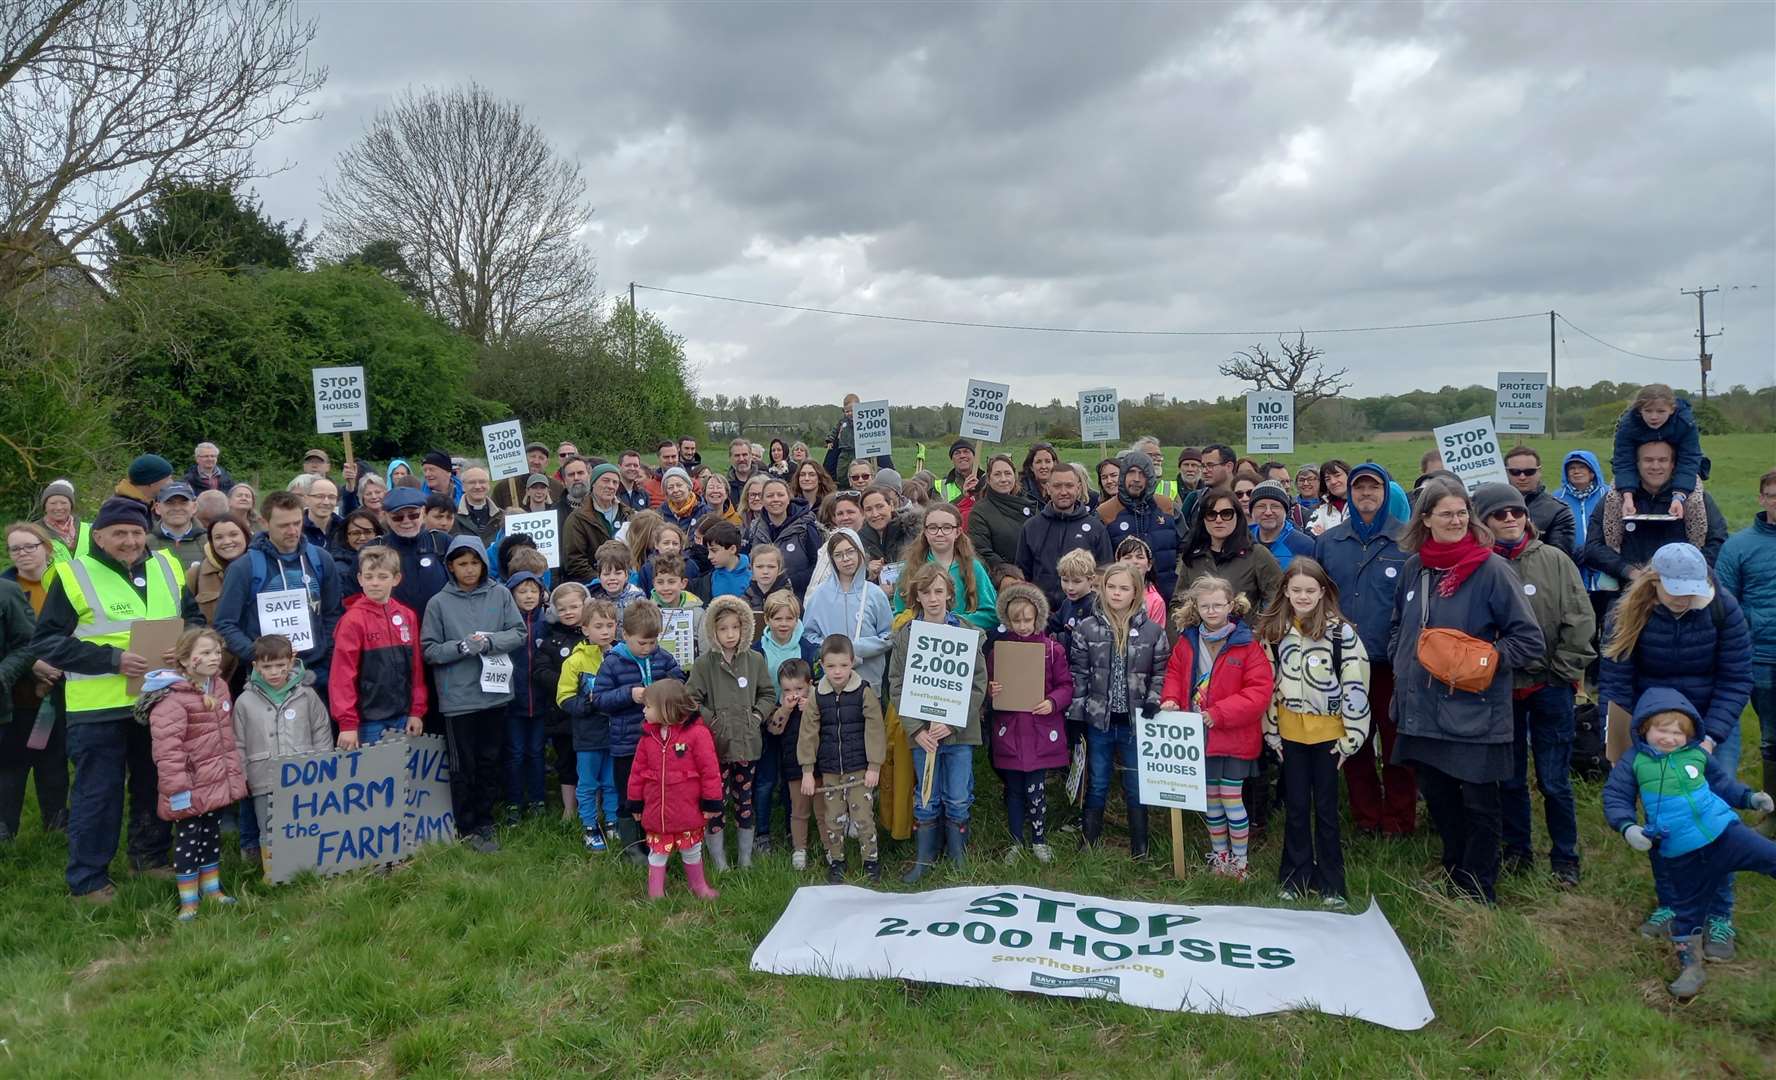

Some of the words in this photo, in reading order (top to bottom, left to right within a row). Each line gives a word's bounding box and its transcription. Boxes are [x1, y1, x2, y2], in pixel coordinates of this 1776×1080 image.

[320, 376, 358, 388] STOP
[1500, 383, 1545, 391] PROTECT
[318, 388, 362, 402] 2,000
[971, 387, 1004, 401] STOP
[1084, 393, 1113, 404] STOP
[1511, 392, 1531, 400] OUR
[322, 401, 361, 411] HOUSES
[967, 398, 1004, 413] 2,000
[1082, 403, 1116, 416] 2,000
[1258, 402, 1283, 415] NO
[1499, 401, 1544, 409] VILLAGES
[857, 408, 885, 420] STOP
[968, 410, 1000, 421] HOUSES
[1264, 414, 1290, 422] MORE
[856, 418, 888, 432] 2,000
[1252, 422, 1289, 430] TRAFFIC
[488, 428, 517, 442] STOP
[859, 430, 887, 440] HOUSES
[1443, 428, 1488, 448] STOP
[488, 438, 522, 454] 2,000
[1444, 441, 1496, 464] 2,000
[492, 450, 521, 463] HOUSES
[1451, 457, 1497, 474] HOUSES
[511, 518, 552, 532] STOP
[265, 599, 302, 613] SAVE
[271, 615, 300, 628] THE
[916, 635, 970, 657] STOP
[909, 653, 970, 678] 2,000
[484, 671, 508, 683] SAVE
[911, 674, 964, 692] HOUSES
[1144, 722, 1196, 741] STOP
[1141, 740, 1201, 762] 2,000
[280, 751, 363, 788] DON'T
[404, 748, 450, 783] AVE
[1146, 761, 1198, 777] HOUSES
[292, 776, 395, 820] HARM
[281, 822, 321, 839] the
[316, 821, 401, 867] FARM
[963, 892, 1202, 938] STOP
[874, 917, 1033, 949] 2,000
[1048, 931, 1296, 970] HOUSES
